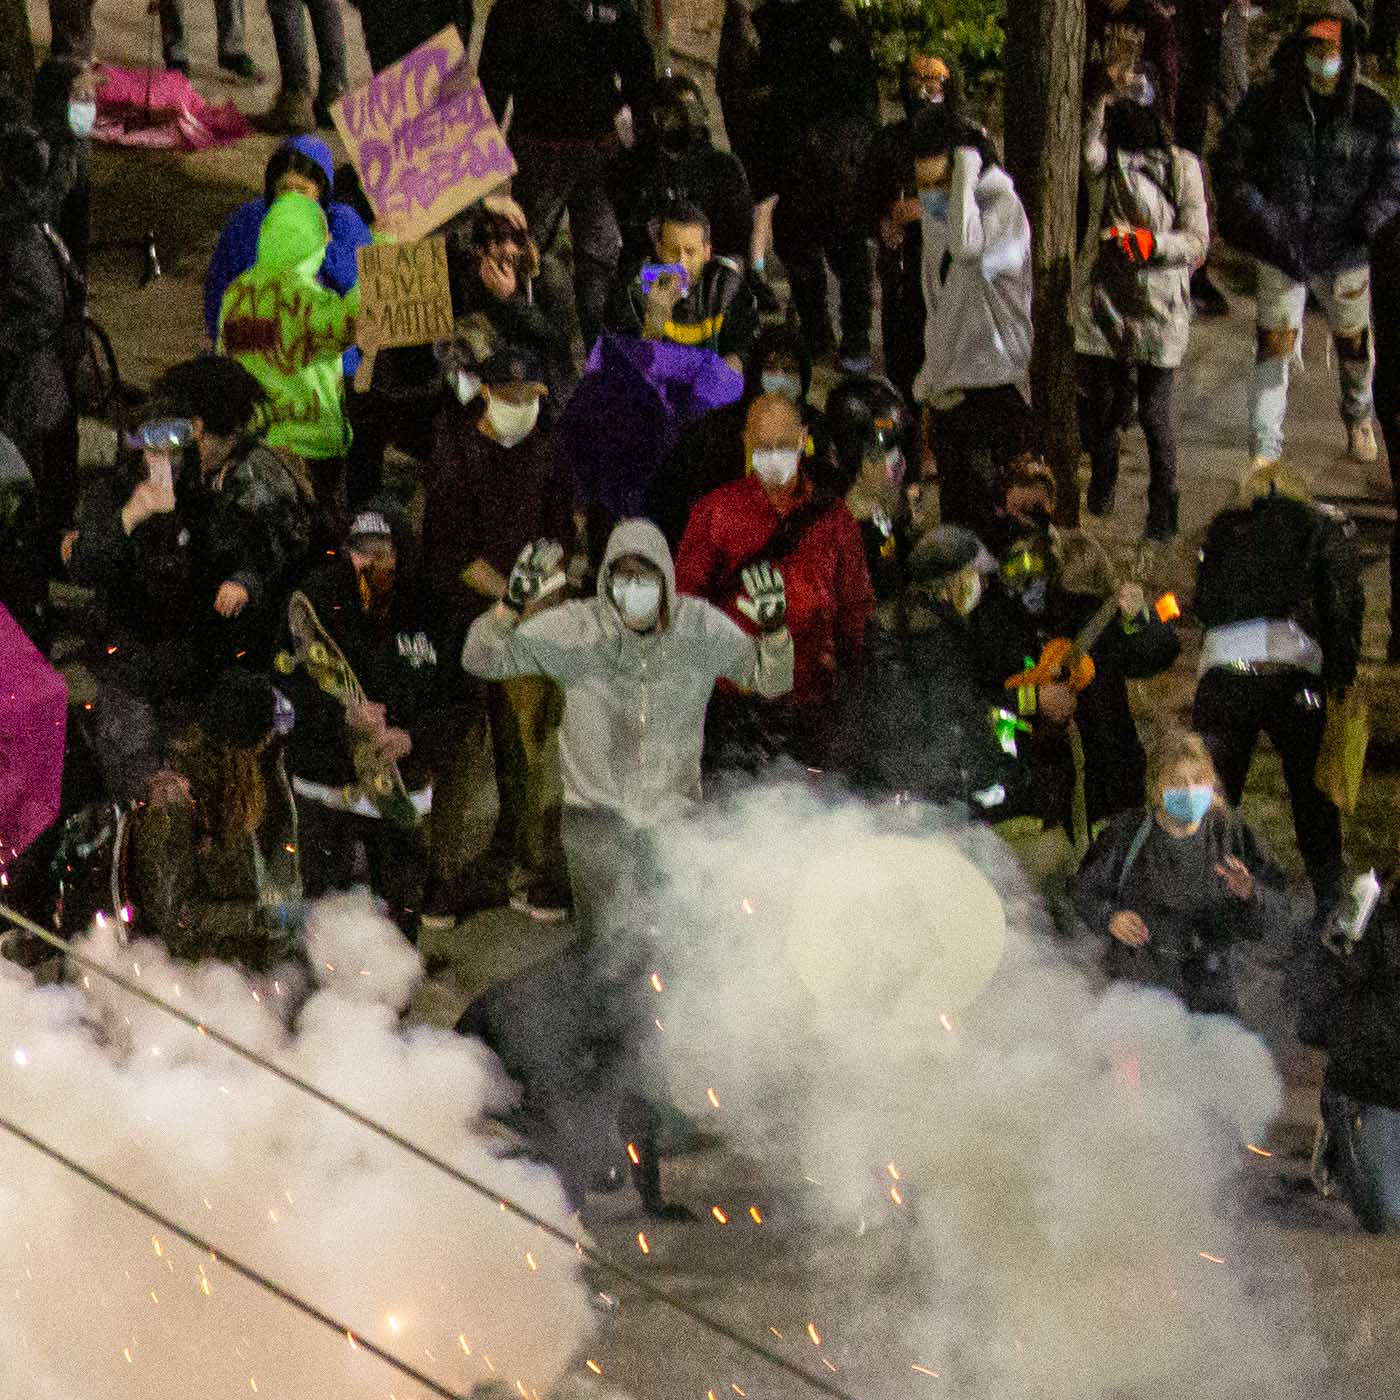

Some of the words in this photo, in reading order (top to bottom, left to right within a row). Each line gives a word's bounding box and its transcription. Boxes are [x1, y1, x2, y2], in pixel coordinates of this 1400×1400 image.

[362, 239, 444, 277] BLACK
[374, 272, 443, 301] LIVES
[380, 299, 452, 338] MATTER
